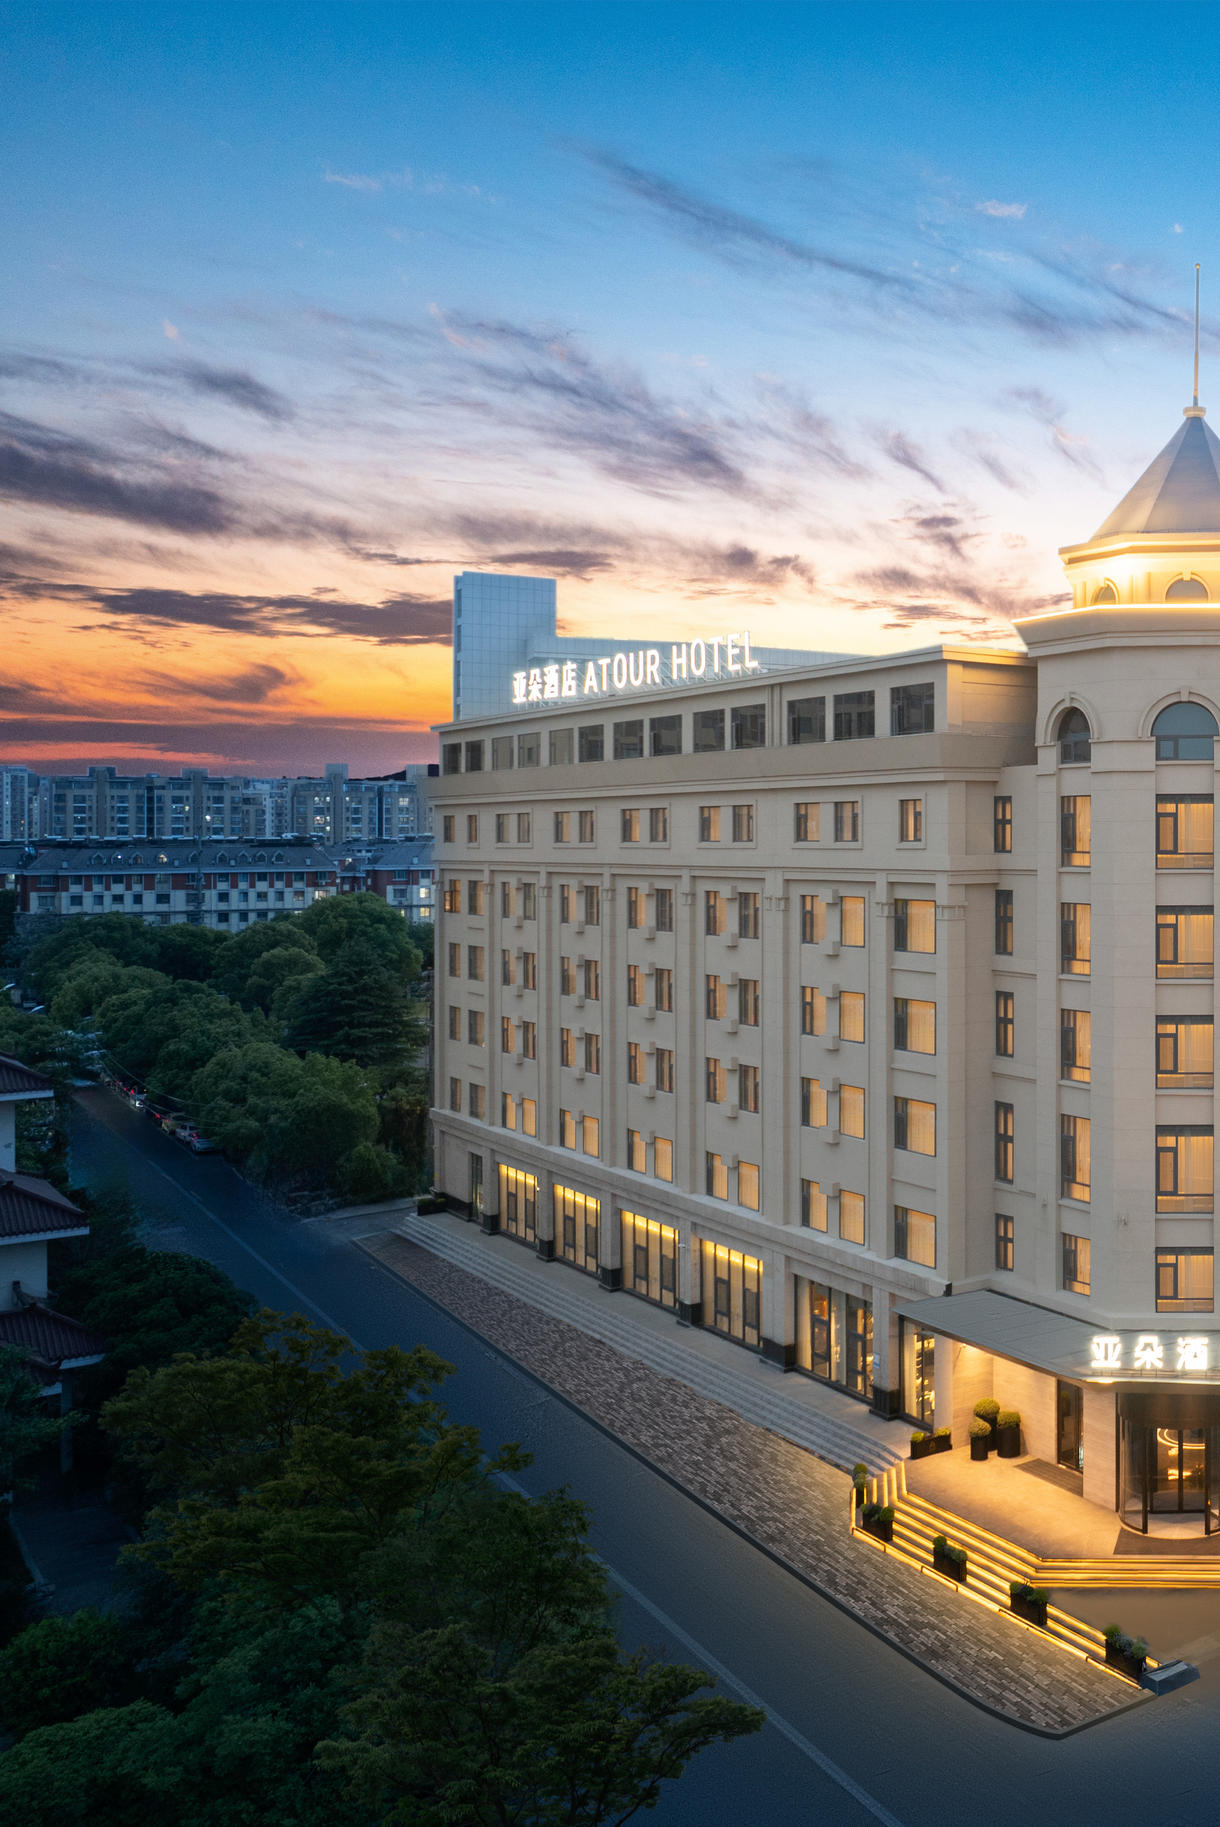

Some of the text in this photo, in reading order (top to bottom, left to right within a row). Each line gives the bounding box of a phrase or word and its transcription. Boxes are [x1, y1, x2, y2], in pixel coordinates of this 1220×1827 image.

[513, 662, 577, 703] 亚朵酒店
[584, 632, 758, 694] ATOUR HOTEL
